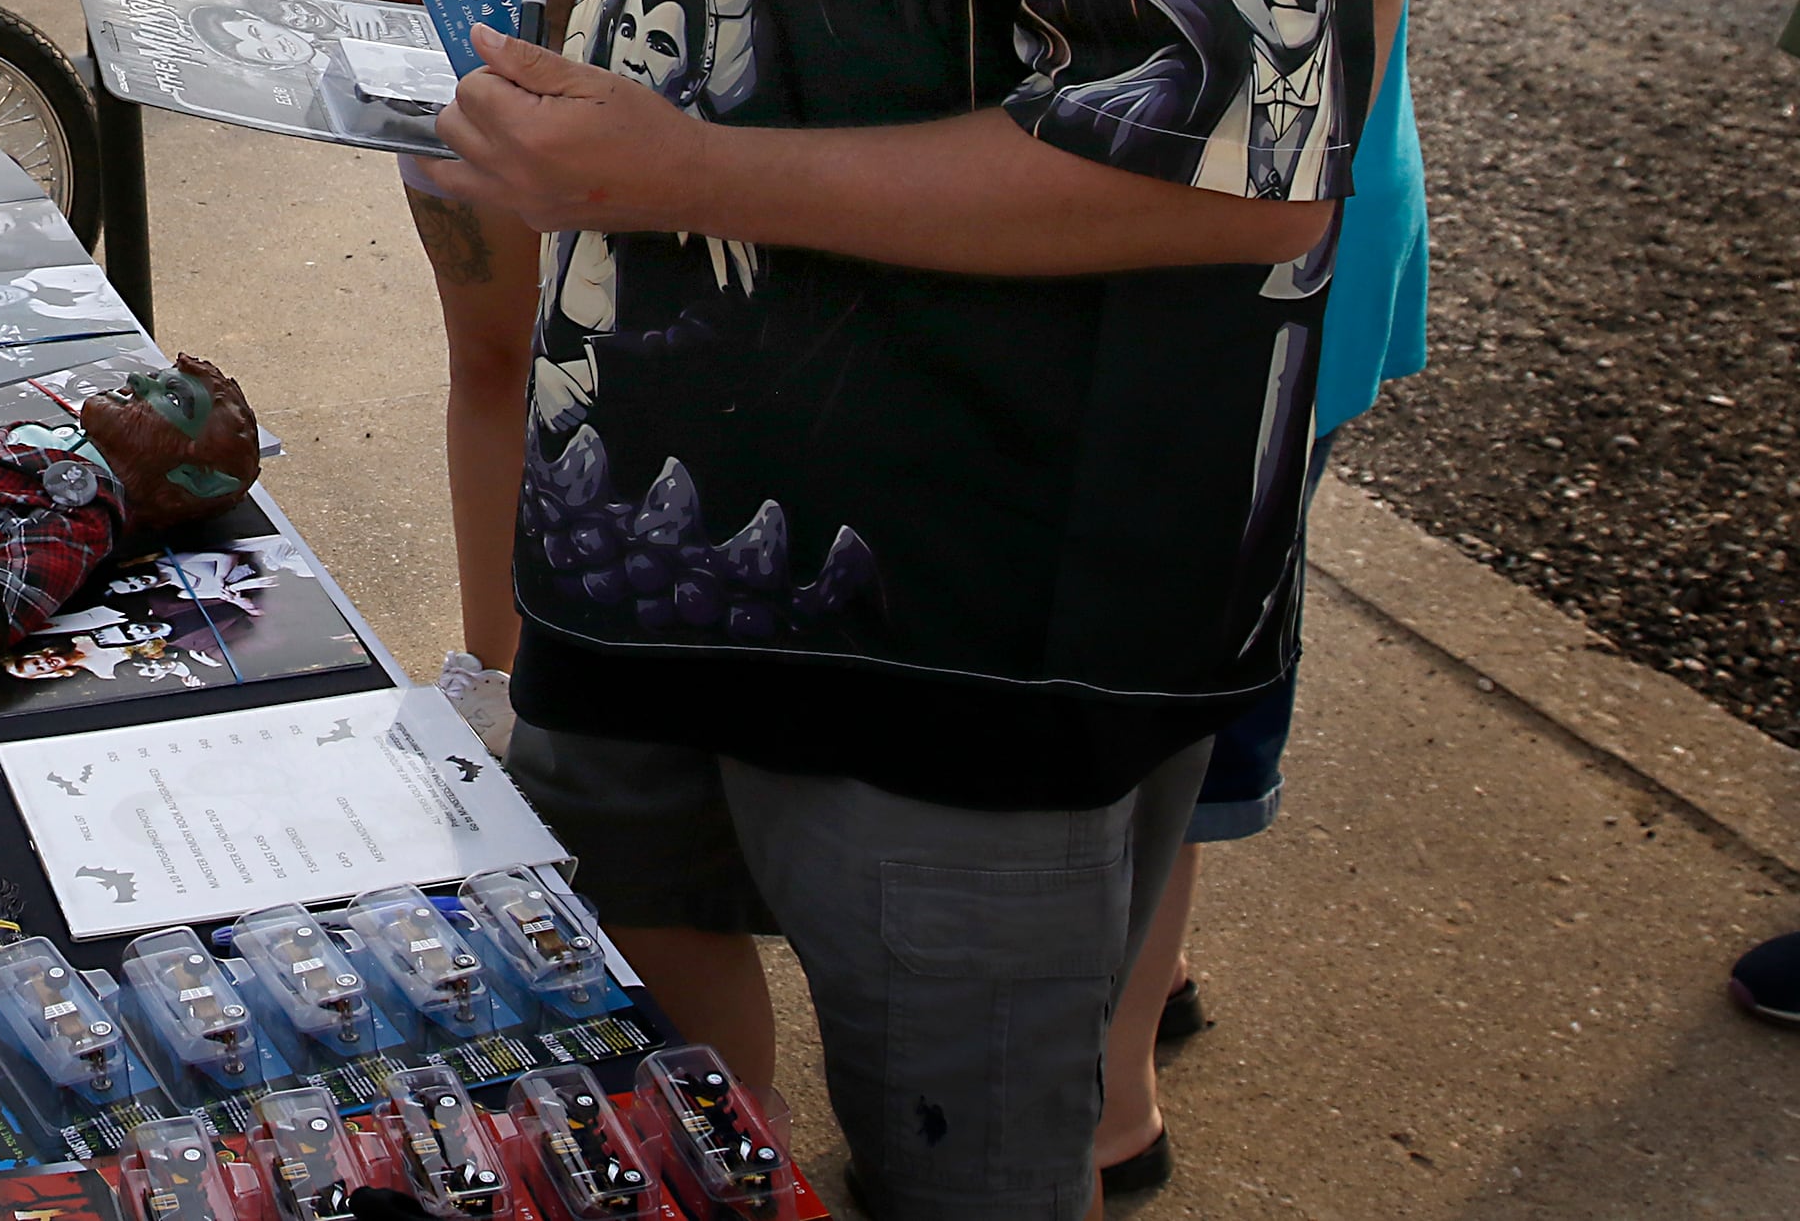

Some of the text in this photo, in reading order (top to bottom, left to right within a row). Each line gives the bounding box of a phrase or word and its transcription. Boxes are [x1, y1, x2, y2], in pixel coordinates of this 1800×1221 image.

[153, 60, 185, 92] THE
[149, 768, 179, 810] AUTOGRAPHED
[407, 784, 424, 798] SOLD
[428, 788, 439, 798] but
[431, 774, 468, 817] MUNSTERS.COM
[337, 797, 357, 819] SIGNED
[435, 798, 448, 811] cash
[136, 808, 152, 829] PHOTO
[171, 810, 189, 829] BOOK
[205, 809, 219, 823] DVD
[443, 811, 459, 827] Prefer
[464, 816, 474, 824] to
[74, 814, 93, 842] PRICE LIST
[212, 822, 230, 842] HOME
[469, 823, 480, 832] Go
[182, 829, 204, 858] MEMORY
[223, 842, 236, 852] GO
[254, 835, 271, 851] CARS
[285, 827, 306, 850] SIGNED
[350, 819, 386, 863] MERCHANDISE
[147, 828, 176, 876] AUTOGRAPHED
[263, 851, 280, 867] CAST
[298, 850, 320, 873] T-SHIRT
[336, 851, 353, 868] CAPS
[196, 858, 221, 889] MUNSTER
[230, 853, 255, 884] MUNSTER
[273, 867, 287, 879] DIE
[169, 874, 182, 883] 10
